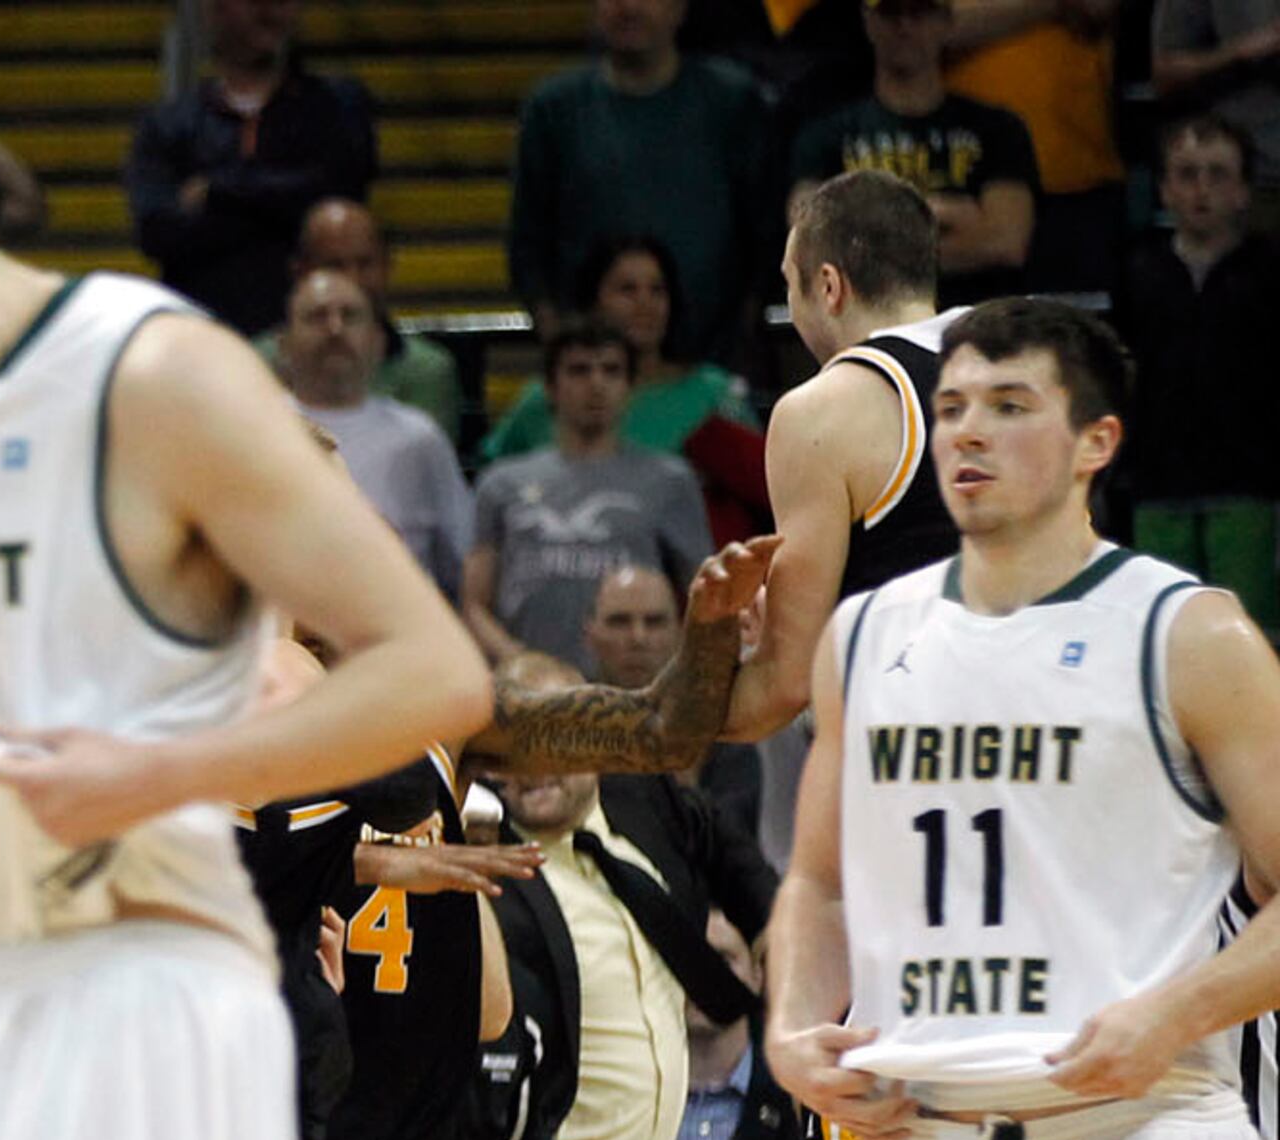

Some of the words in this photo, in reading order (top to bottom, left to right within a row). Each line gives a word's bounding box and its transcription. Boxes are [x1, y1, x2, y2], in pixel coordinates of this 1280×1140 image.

[867, 724, 1082, 783] WRIGHT
[911, 807, 1005, 927] 11
[899, 957, 1049, 1017] STATE
